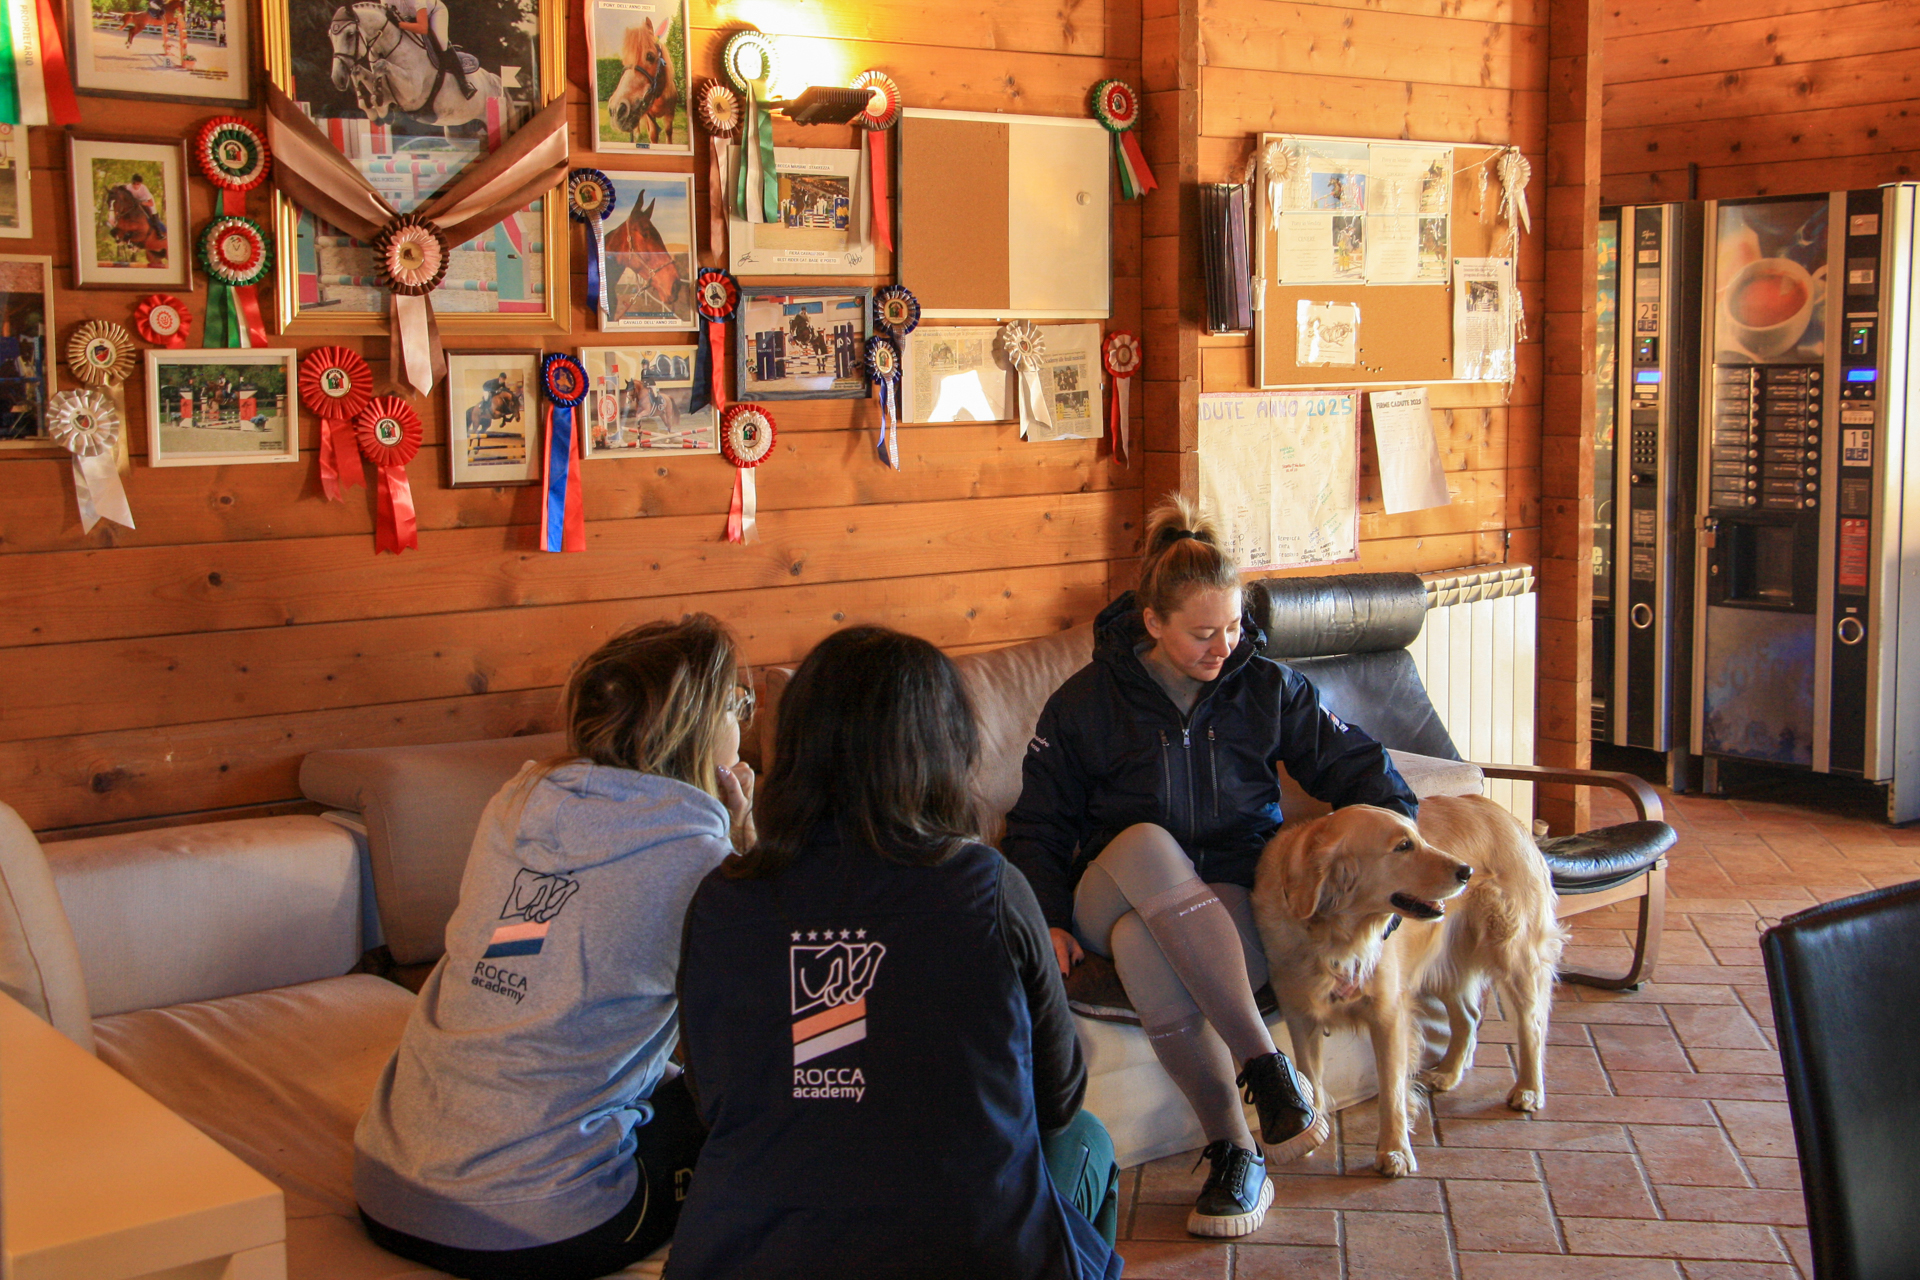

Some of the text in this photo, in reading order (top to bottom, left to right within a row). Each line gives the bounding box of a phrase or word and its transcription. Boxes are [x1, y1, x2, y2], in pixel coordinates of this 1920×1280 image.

[20, 4, 34, 66] PROPRIETARIO
[1256, 400, 1298, 418] ANNO
[1306, 398, 1352, 416] 2025
[474, 961, 528, 991] ROCCA
[472, 976, 525, 1004] academy
[794, 1068, 866, 1085] ROCCA
[793, 1083, 866, 1103] academy
